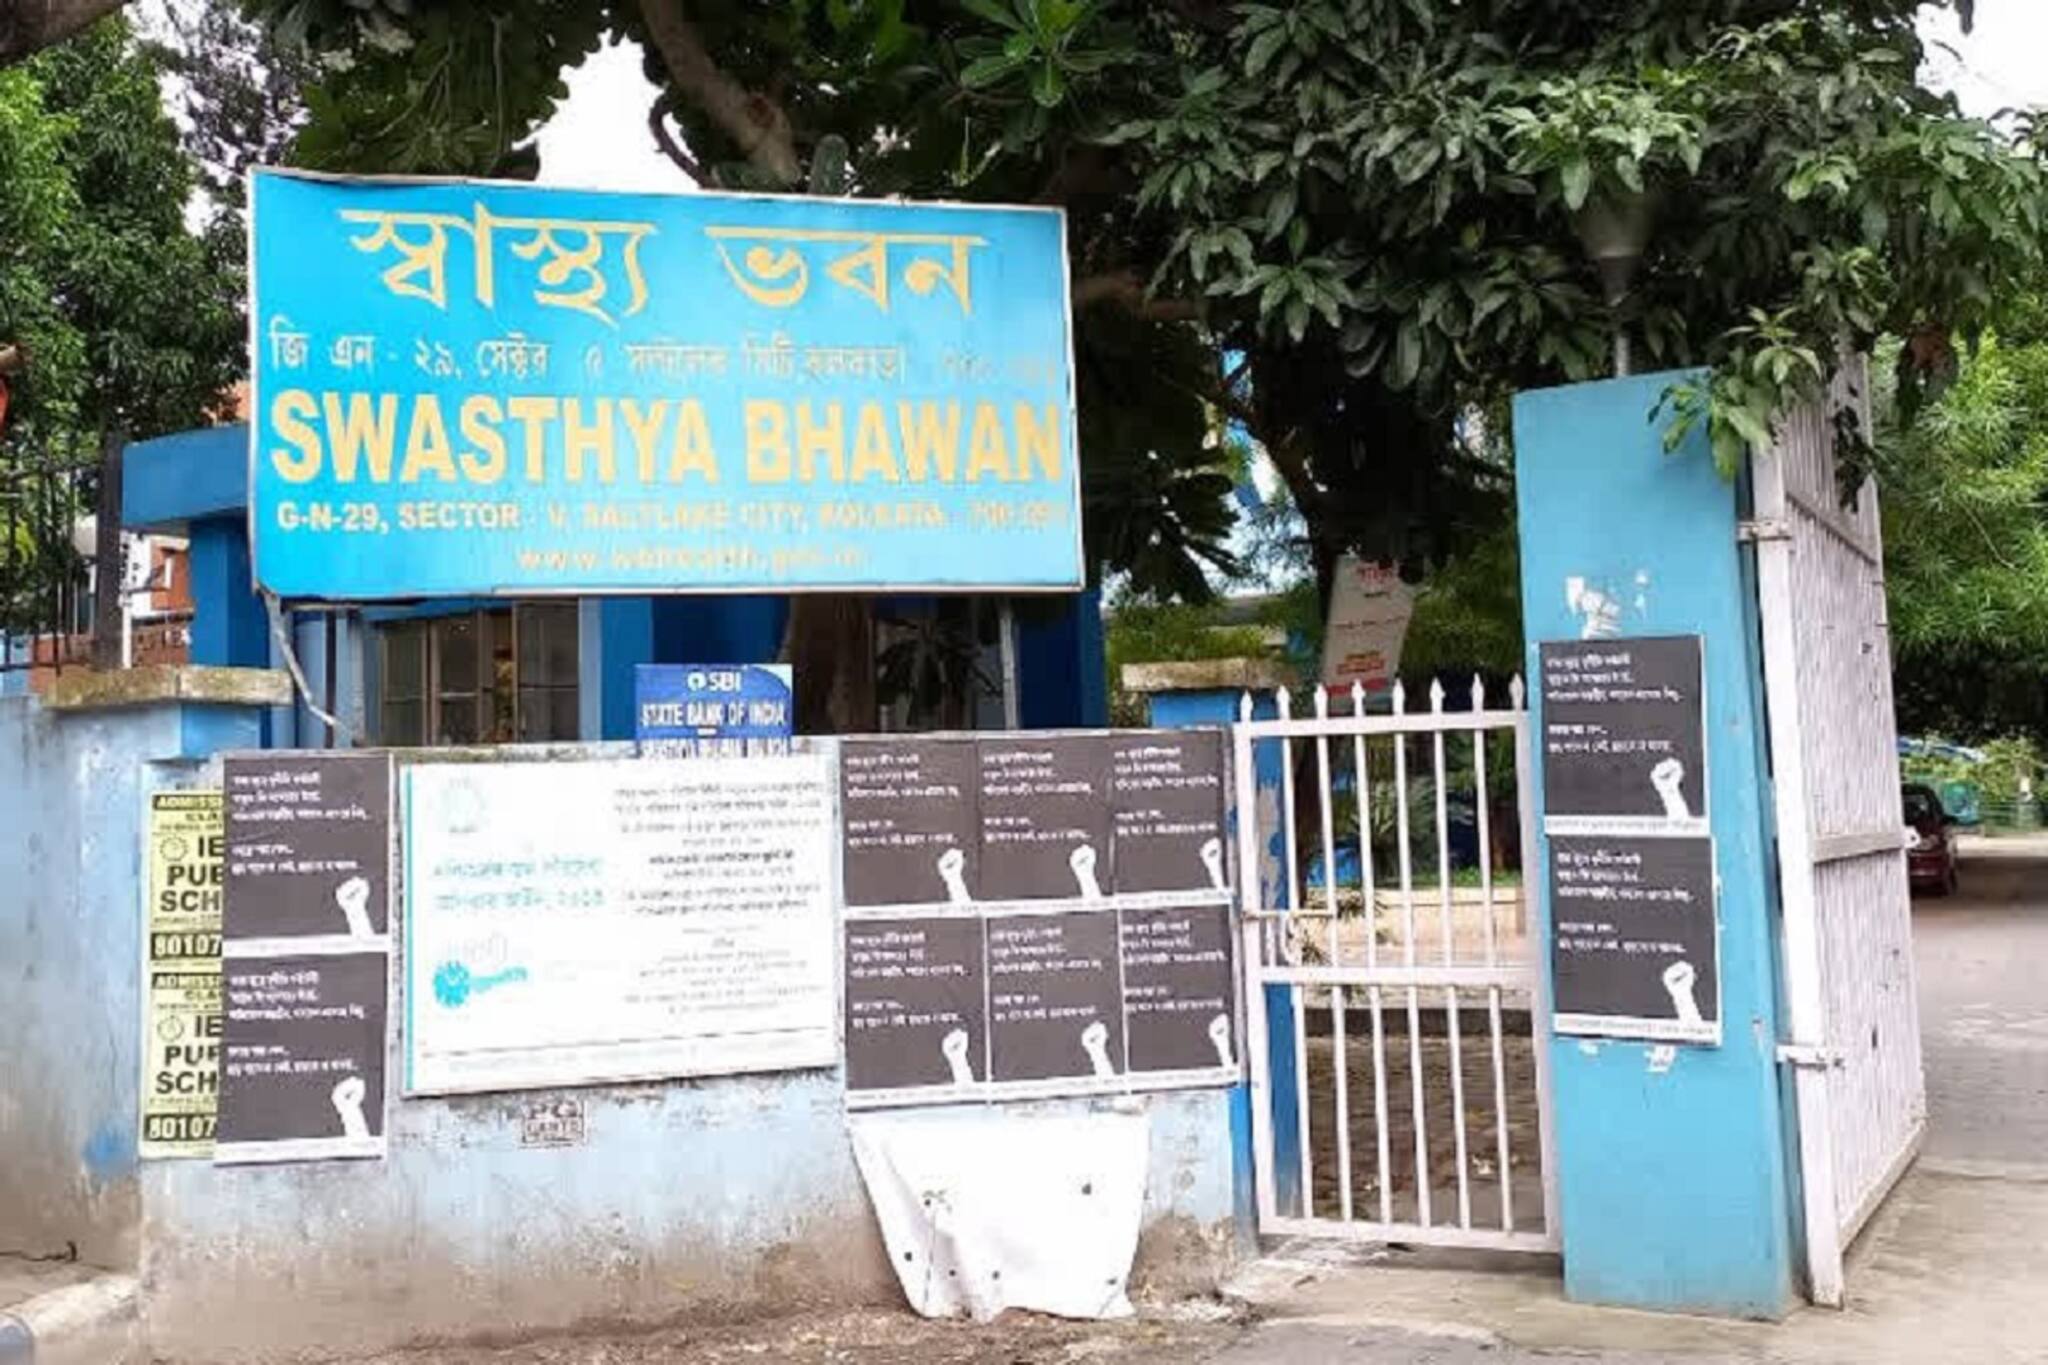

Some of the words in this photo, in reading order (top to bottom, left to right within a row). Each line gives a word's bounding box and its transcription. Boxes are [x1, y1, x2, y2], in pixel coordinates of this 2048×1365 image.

[339, 201, 659, 329] স্বাস্থ্য
[704, 226, 990, 316] ভবন
[269, 314, 309, 371] জি
[330, 333, 376, 369] এন
[269, 387, 720, 485] SWASTHYA
[744, 394, 1063, 485] BHAWAN
[276, 502, 390, 534] G-N-29,
[399, 502, 521, 530] SECTOR
[707, 671, 742, 692] SBI
[641, 702, 684, 727] STATE
[686, 702, 724, 726] BANK
[727, 702, 746, 726] OF
[750, 701, 786, 727] INDIA
[160, 890, 220, 912] SCH
[155, 1071, 217, 1095] SCH
